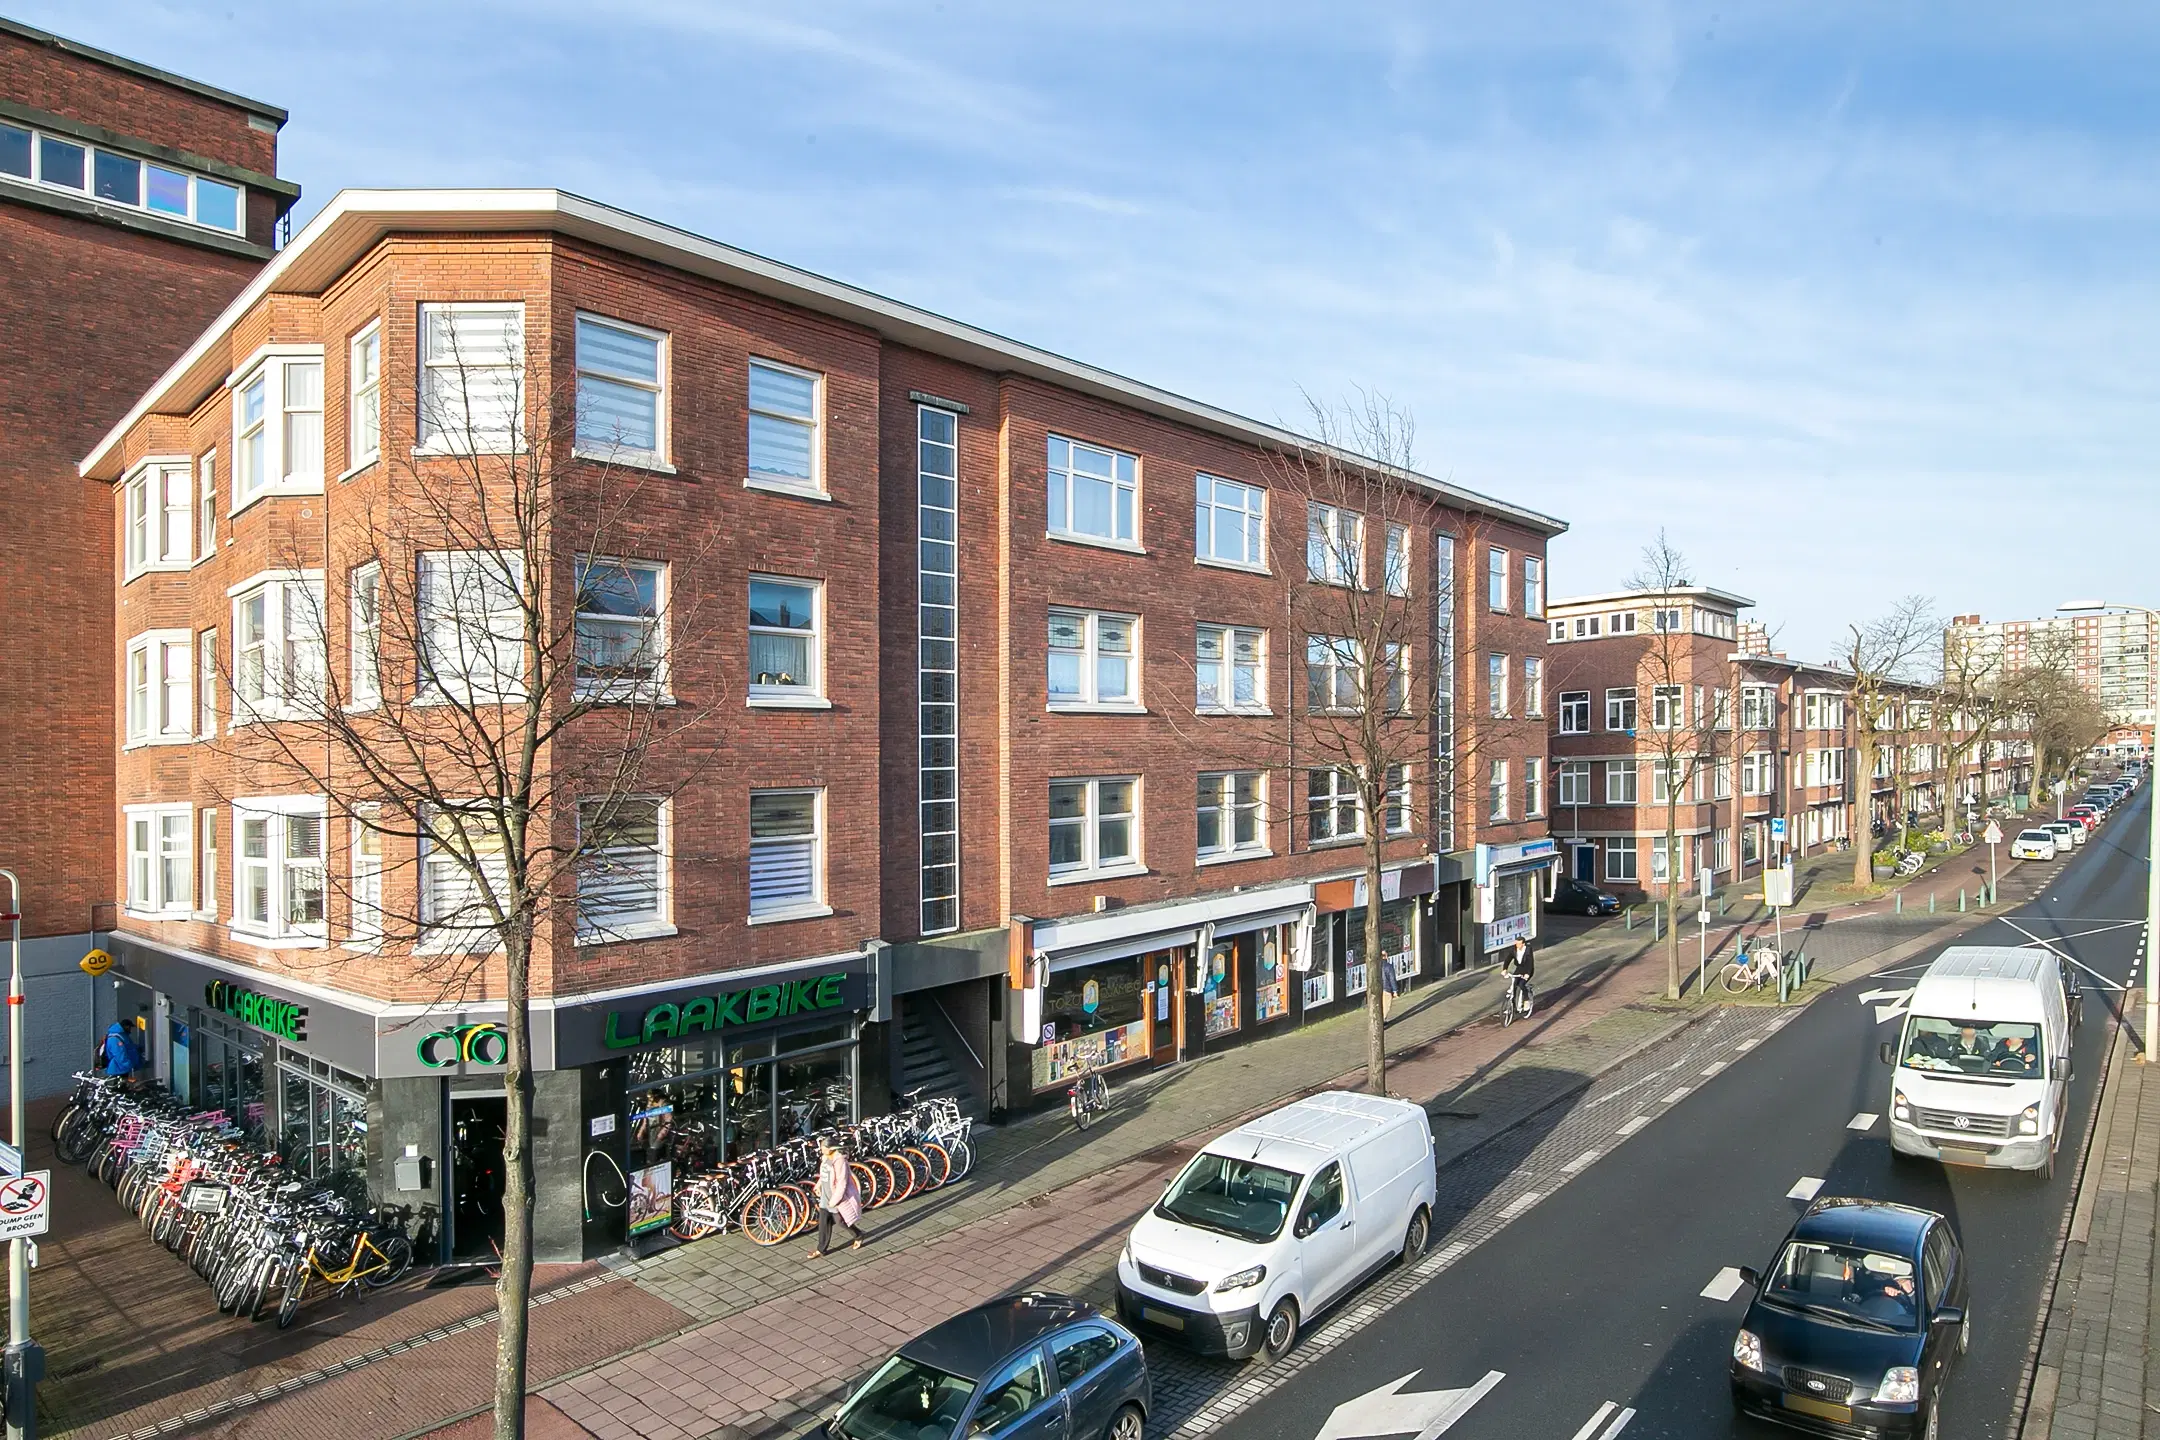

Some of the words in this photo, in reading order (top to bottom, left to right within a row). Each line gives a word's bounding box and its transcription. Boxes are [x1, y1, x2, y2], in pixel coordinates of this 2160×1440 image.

[225, 984, 308, 1041] LAAKBIKE
[604, 973, 847, 1049] LAAKBIKE
[6, 1223, 34, 1232] BROOD
[24, 1213, 43, 1221] GEEN
